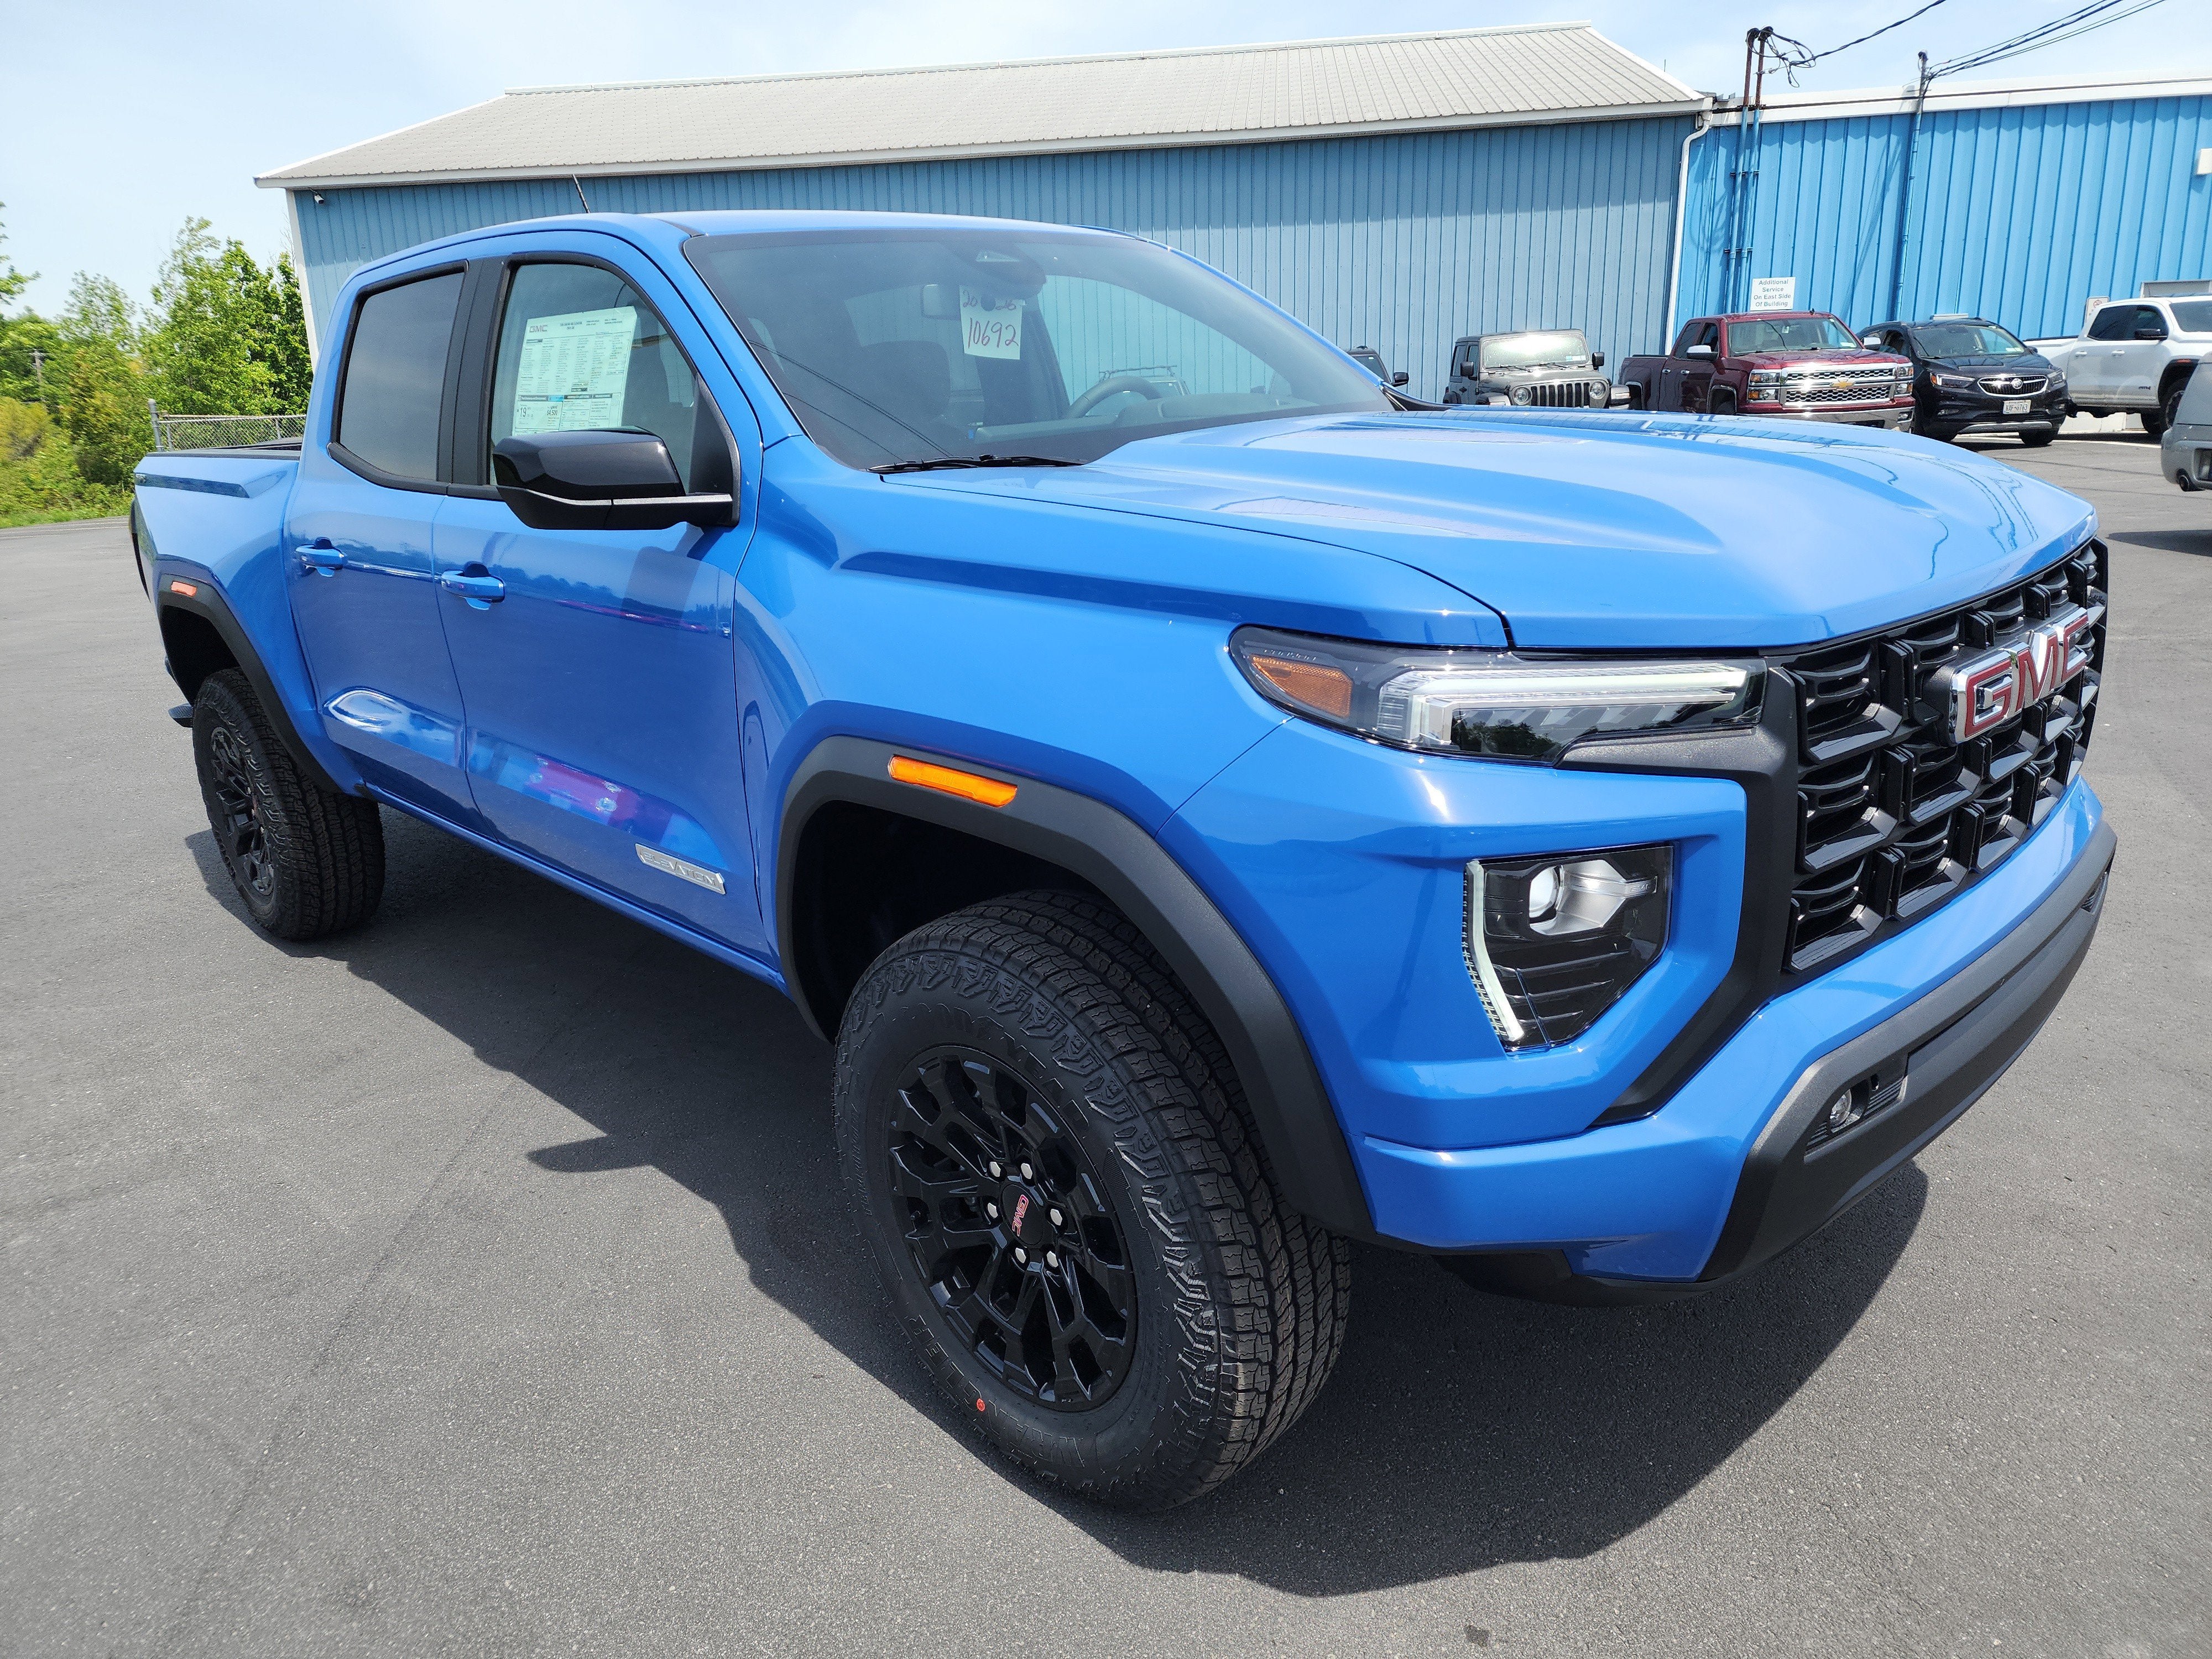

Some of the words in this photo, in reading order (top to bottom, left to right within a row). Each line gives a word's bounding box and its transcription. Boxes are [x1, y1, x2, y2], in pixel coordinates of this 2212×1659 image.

[529, 325, 548, 333] GMC
[968, 317, 1019, 349] 10692
[520, 407, 527, 418] 19
[1950, 607, 2089, 744] GMC
[642, 851, 716, 886] ELEVATION
[1012, 1194, 1029, 1237] GMC
